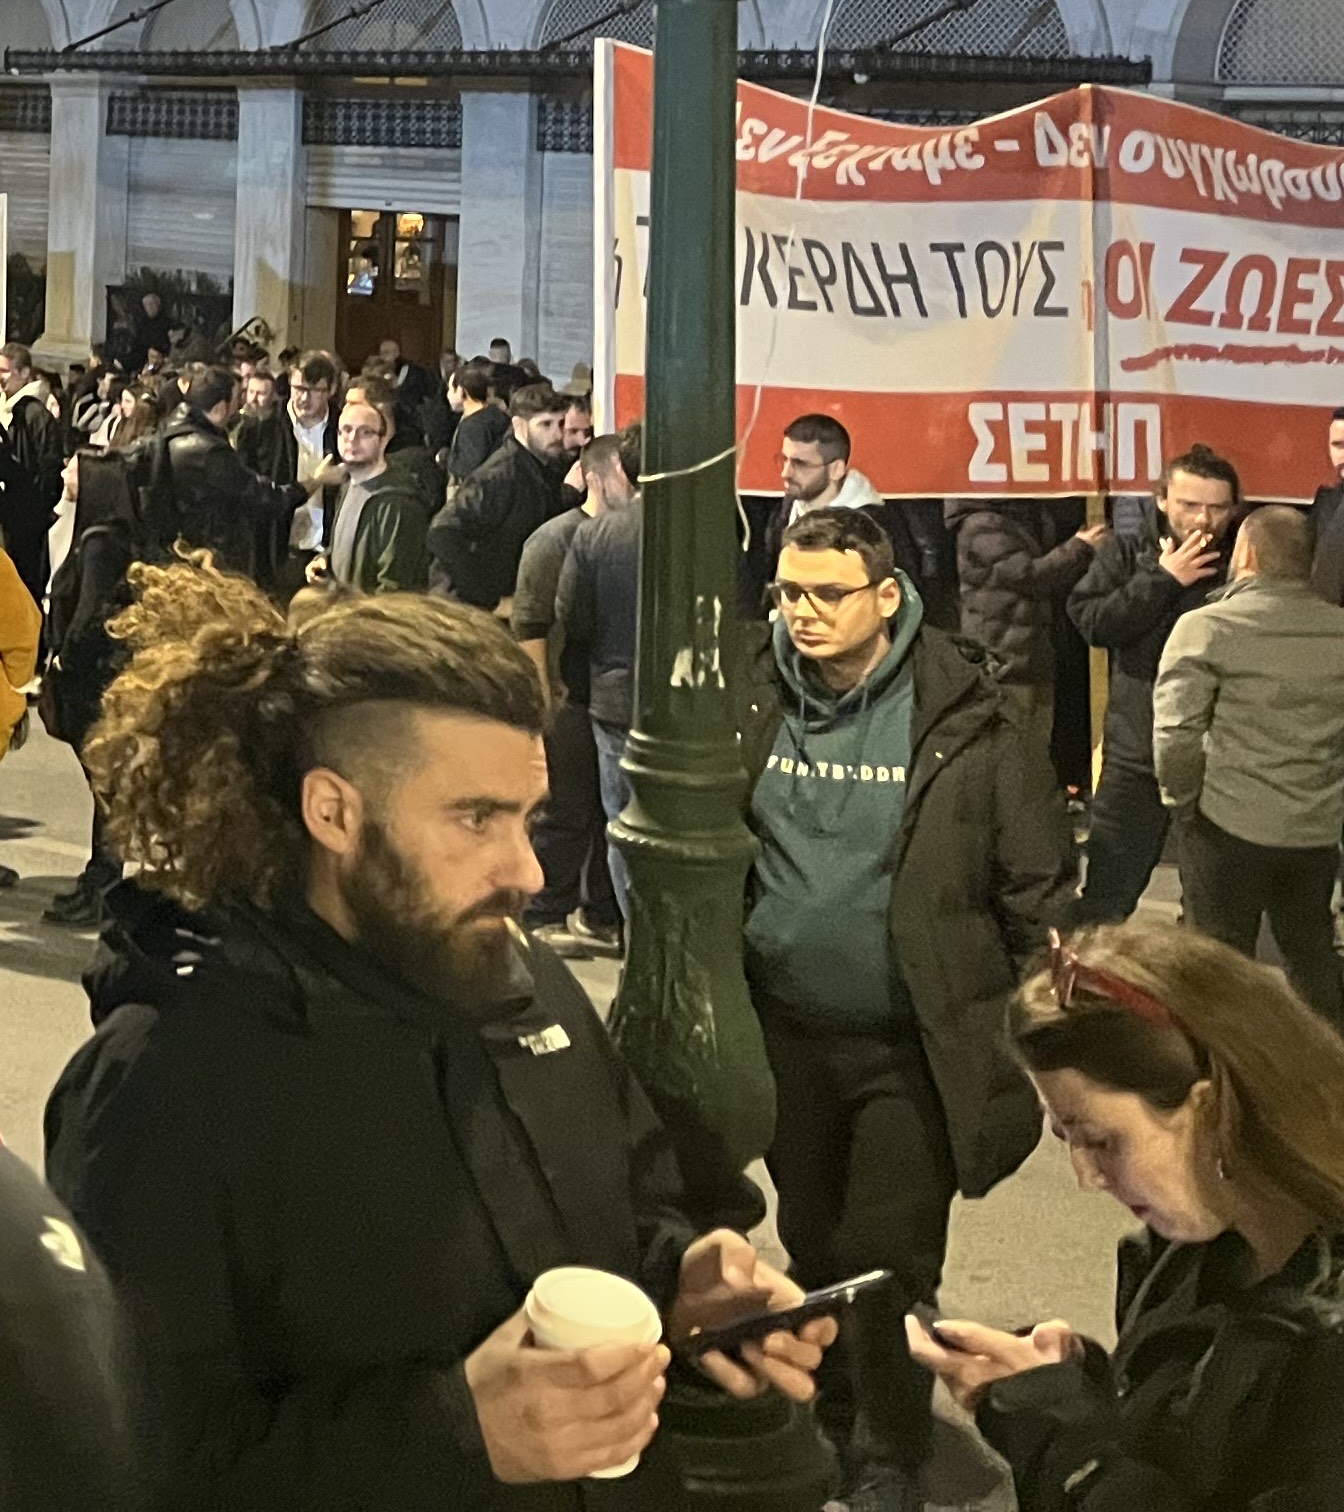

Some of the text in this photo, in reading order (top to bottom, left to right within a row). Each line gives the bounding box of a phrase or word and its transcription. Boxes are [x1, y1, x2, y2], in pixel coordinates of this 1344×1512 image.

[1034, 111, 1111, 168] Δεν
[1119, 129, 1344, 211] συγχωρου
[740, 226, 928, 320] ΚΕΡΔΗ
[931, 239, 1069, 319] ΤΟΥΣ
[1104, 239, 1156, 319] ΟΙ
[968, 402, 1161, 482] ΣΕΤΗΠ
